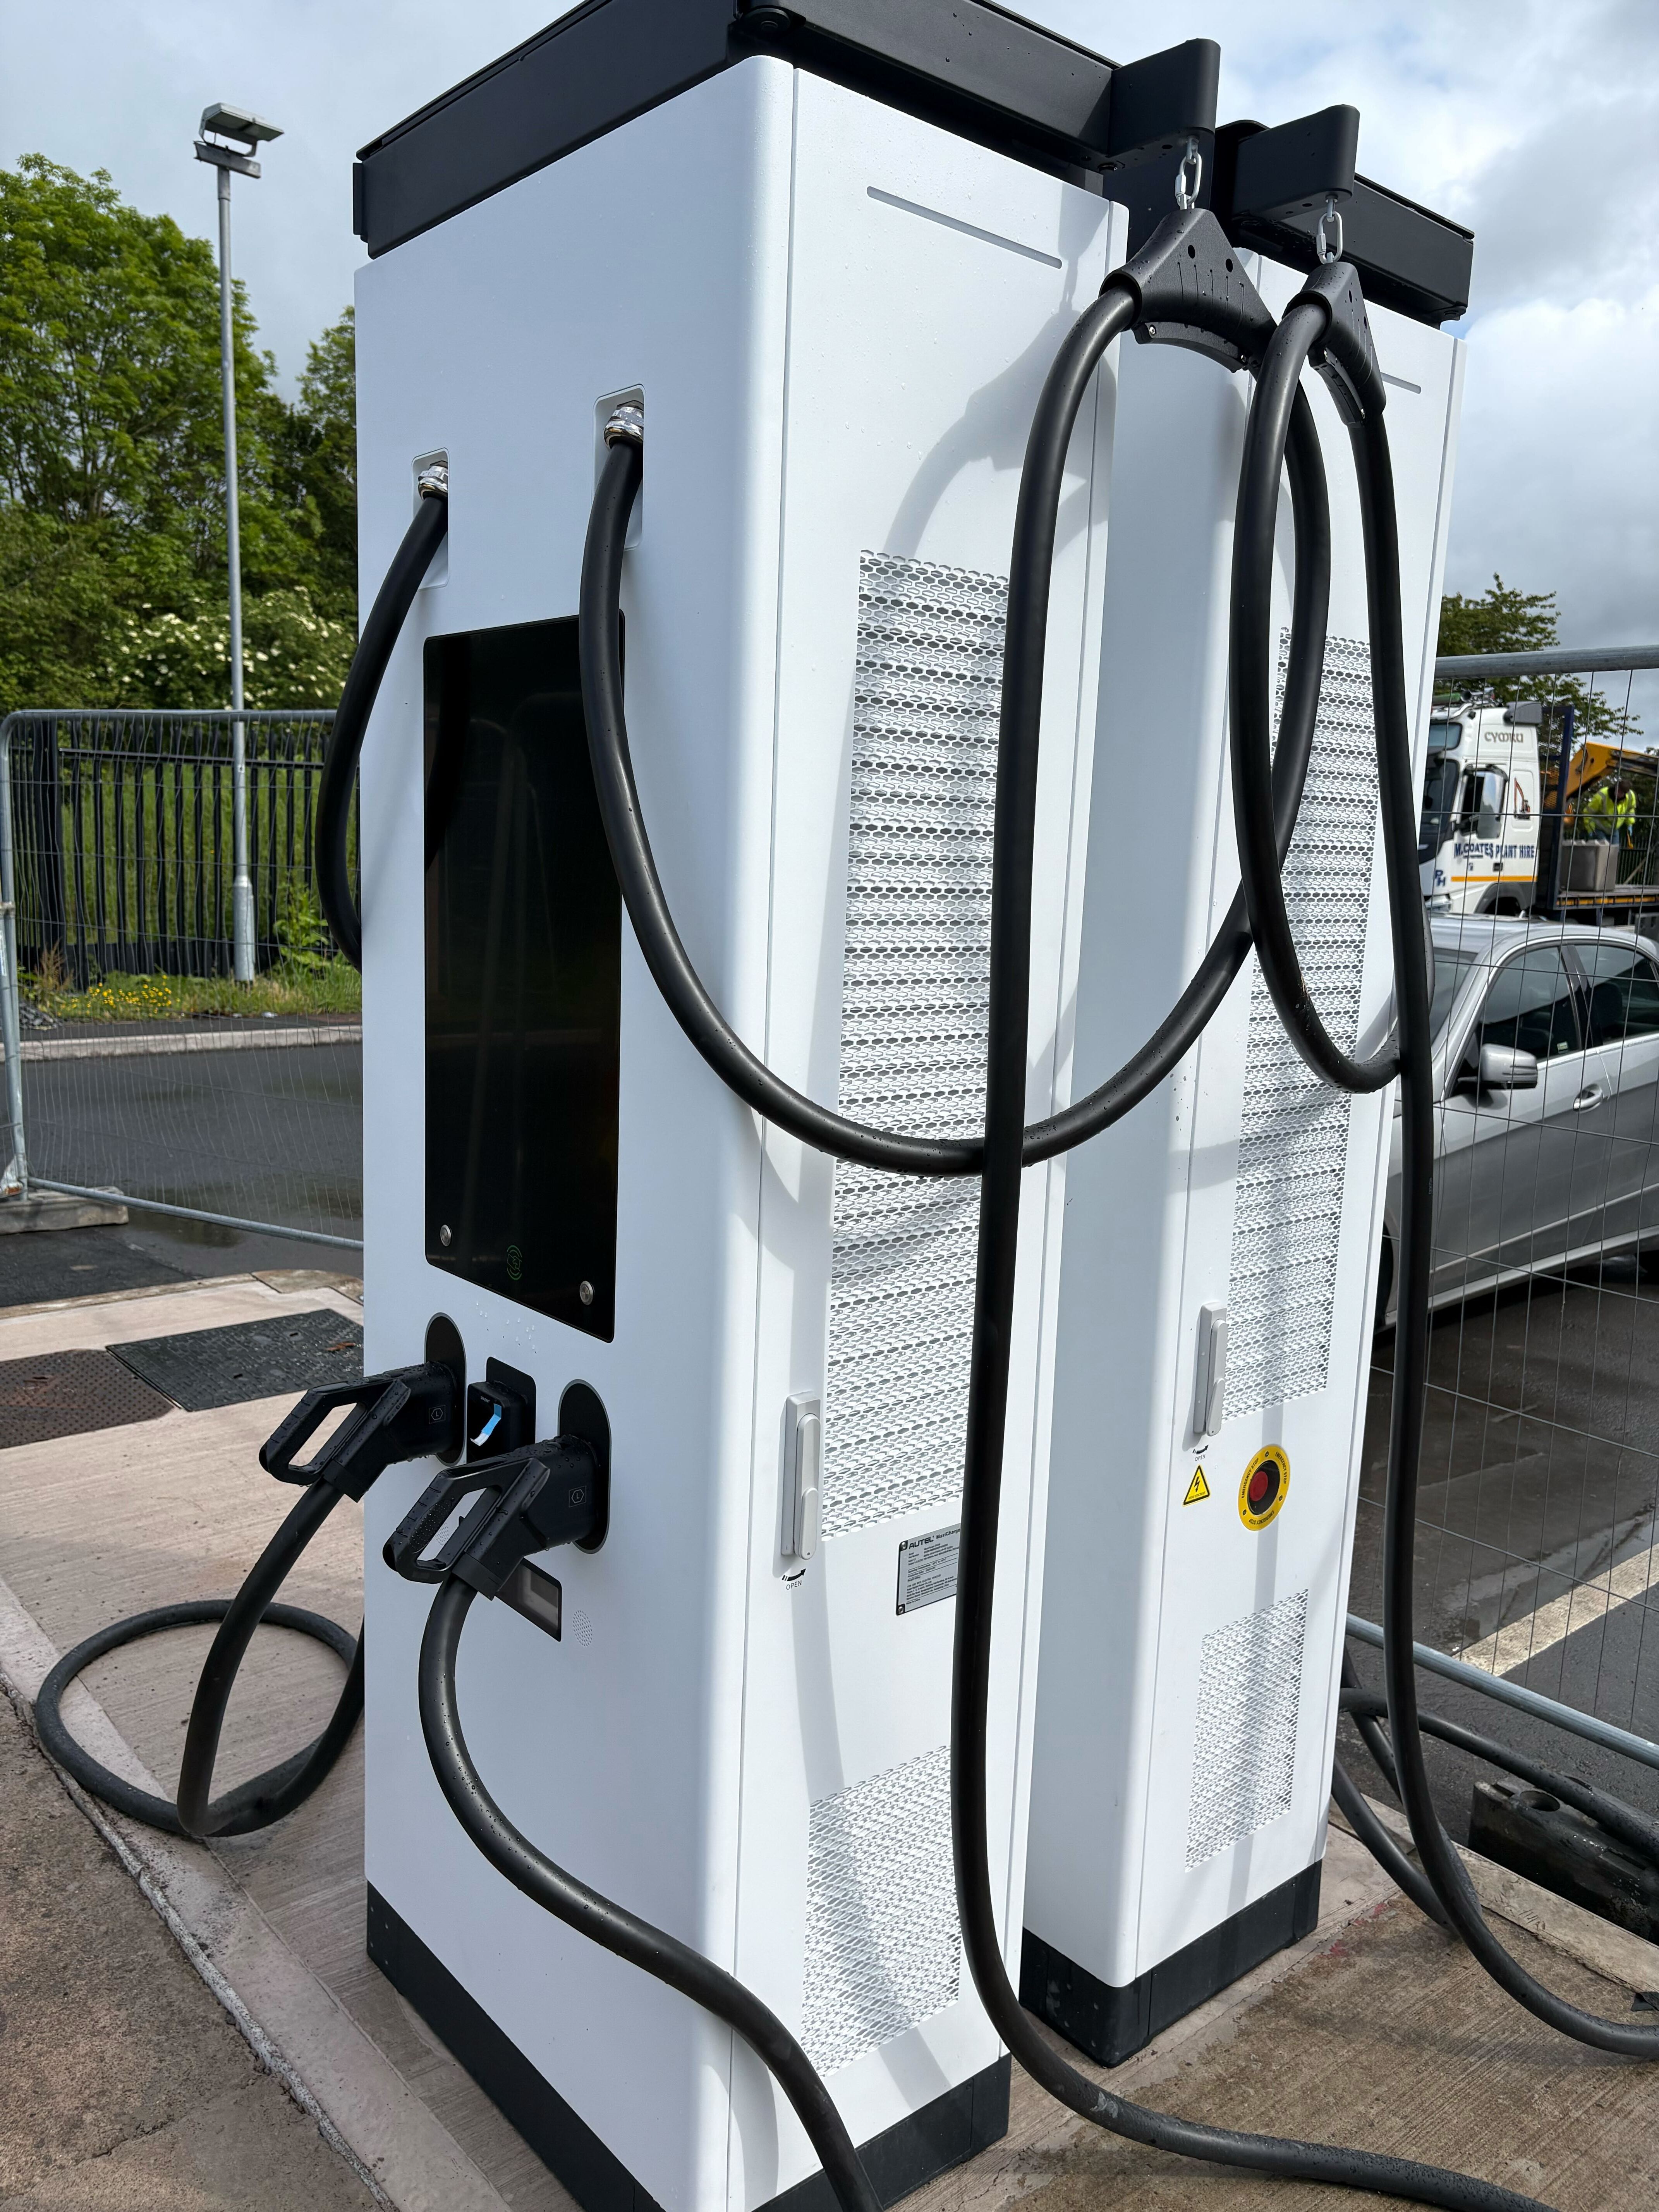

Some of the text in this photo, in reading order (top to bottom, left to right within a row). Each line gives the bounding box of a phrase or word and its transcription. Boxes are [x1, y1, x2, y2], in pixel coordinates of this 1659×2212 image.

[1496, 845, 1517, 858] PLANT
[1519, 845, 1534, 858] HIRE
[1241, 1468, 1252, 1498] EMERGENCY
[908, 1537, 934, 1549] AUTEL
[786, 1580, 802, 1590] OPEN
